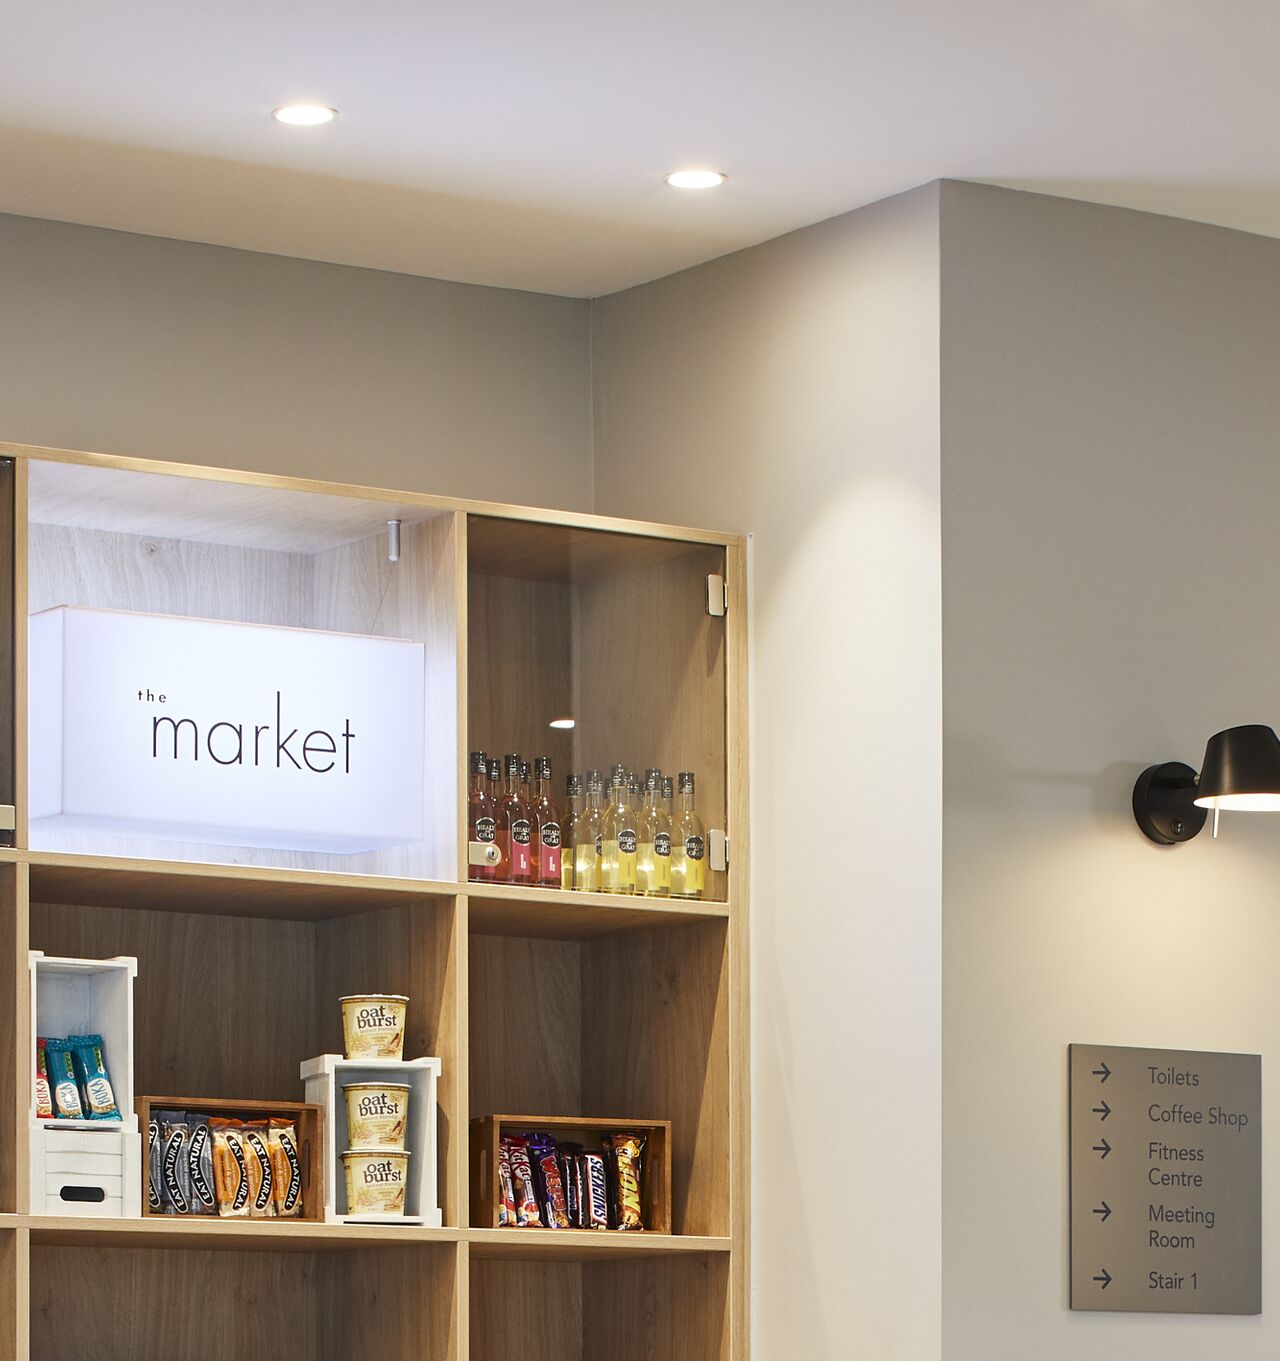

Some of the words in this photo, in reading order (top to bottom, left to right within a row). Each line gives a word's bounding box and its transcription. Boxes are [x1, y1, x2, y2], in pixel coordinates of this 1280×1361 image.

[138, 689, 167, 703] the
[153, 691, 356, 774] market
[360, 1005, 385, 1018] oat
[357, 1015, 397, 1029] burst
[1148, 1066, 1200, 1086] Toilets
[90, 1079, 111, 1105] BOKA
[362, 1093, 388, 1107] oat
[358, 1103, 399, 1117] burst
[1148, 1104, 1203, 1124] Coffee
[1208, 1107, 1249, 1132] Shop
[190, 1130, 206, 1179] NATURAL
[229, 1139, 243, 1159] EAT
[251, 1138, 265, 1158] EAT
[282, 1138, 295, 1157] EAT
[1148, 1142, 1204, 1161] Fitness
[165, 1135, 181, 1186] NATURAL
[367, 1160, 392, 1173] oat
[257, 1158, 271, 1206] NATURAL
[286, 1158, 300, 1207] NATURAL
[363, 1170, 402, 1183] burst
[1148, 1168, 1203, 1187] Centre
[171, 1187, 184, 1207] EAT
[197, 1181, 210, 1200] EAT
[590, 1157, 607, 1220] SNICKERS
[1148, 1204, 1215, 1229] Meeting
[1148, 1230, 1195, 1249] Room
[1148, 1272, 1184, 1289] Stair
[1191, 1273, 1198, 1290] 1
